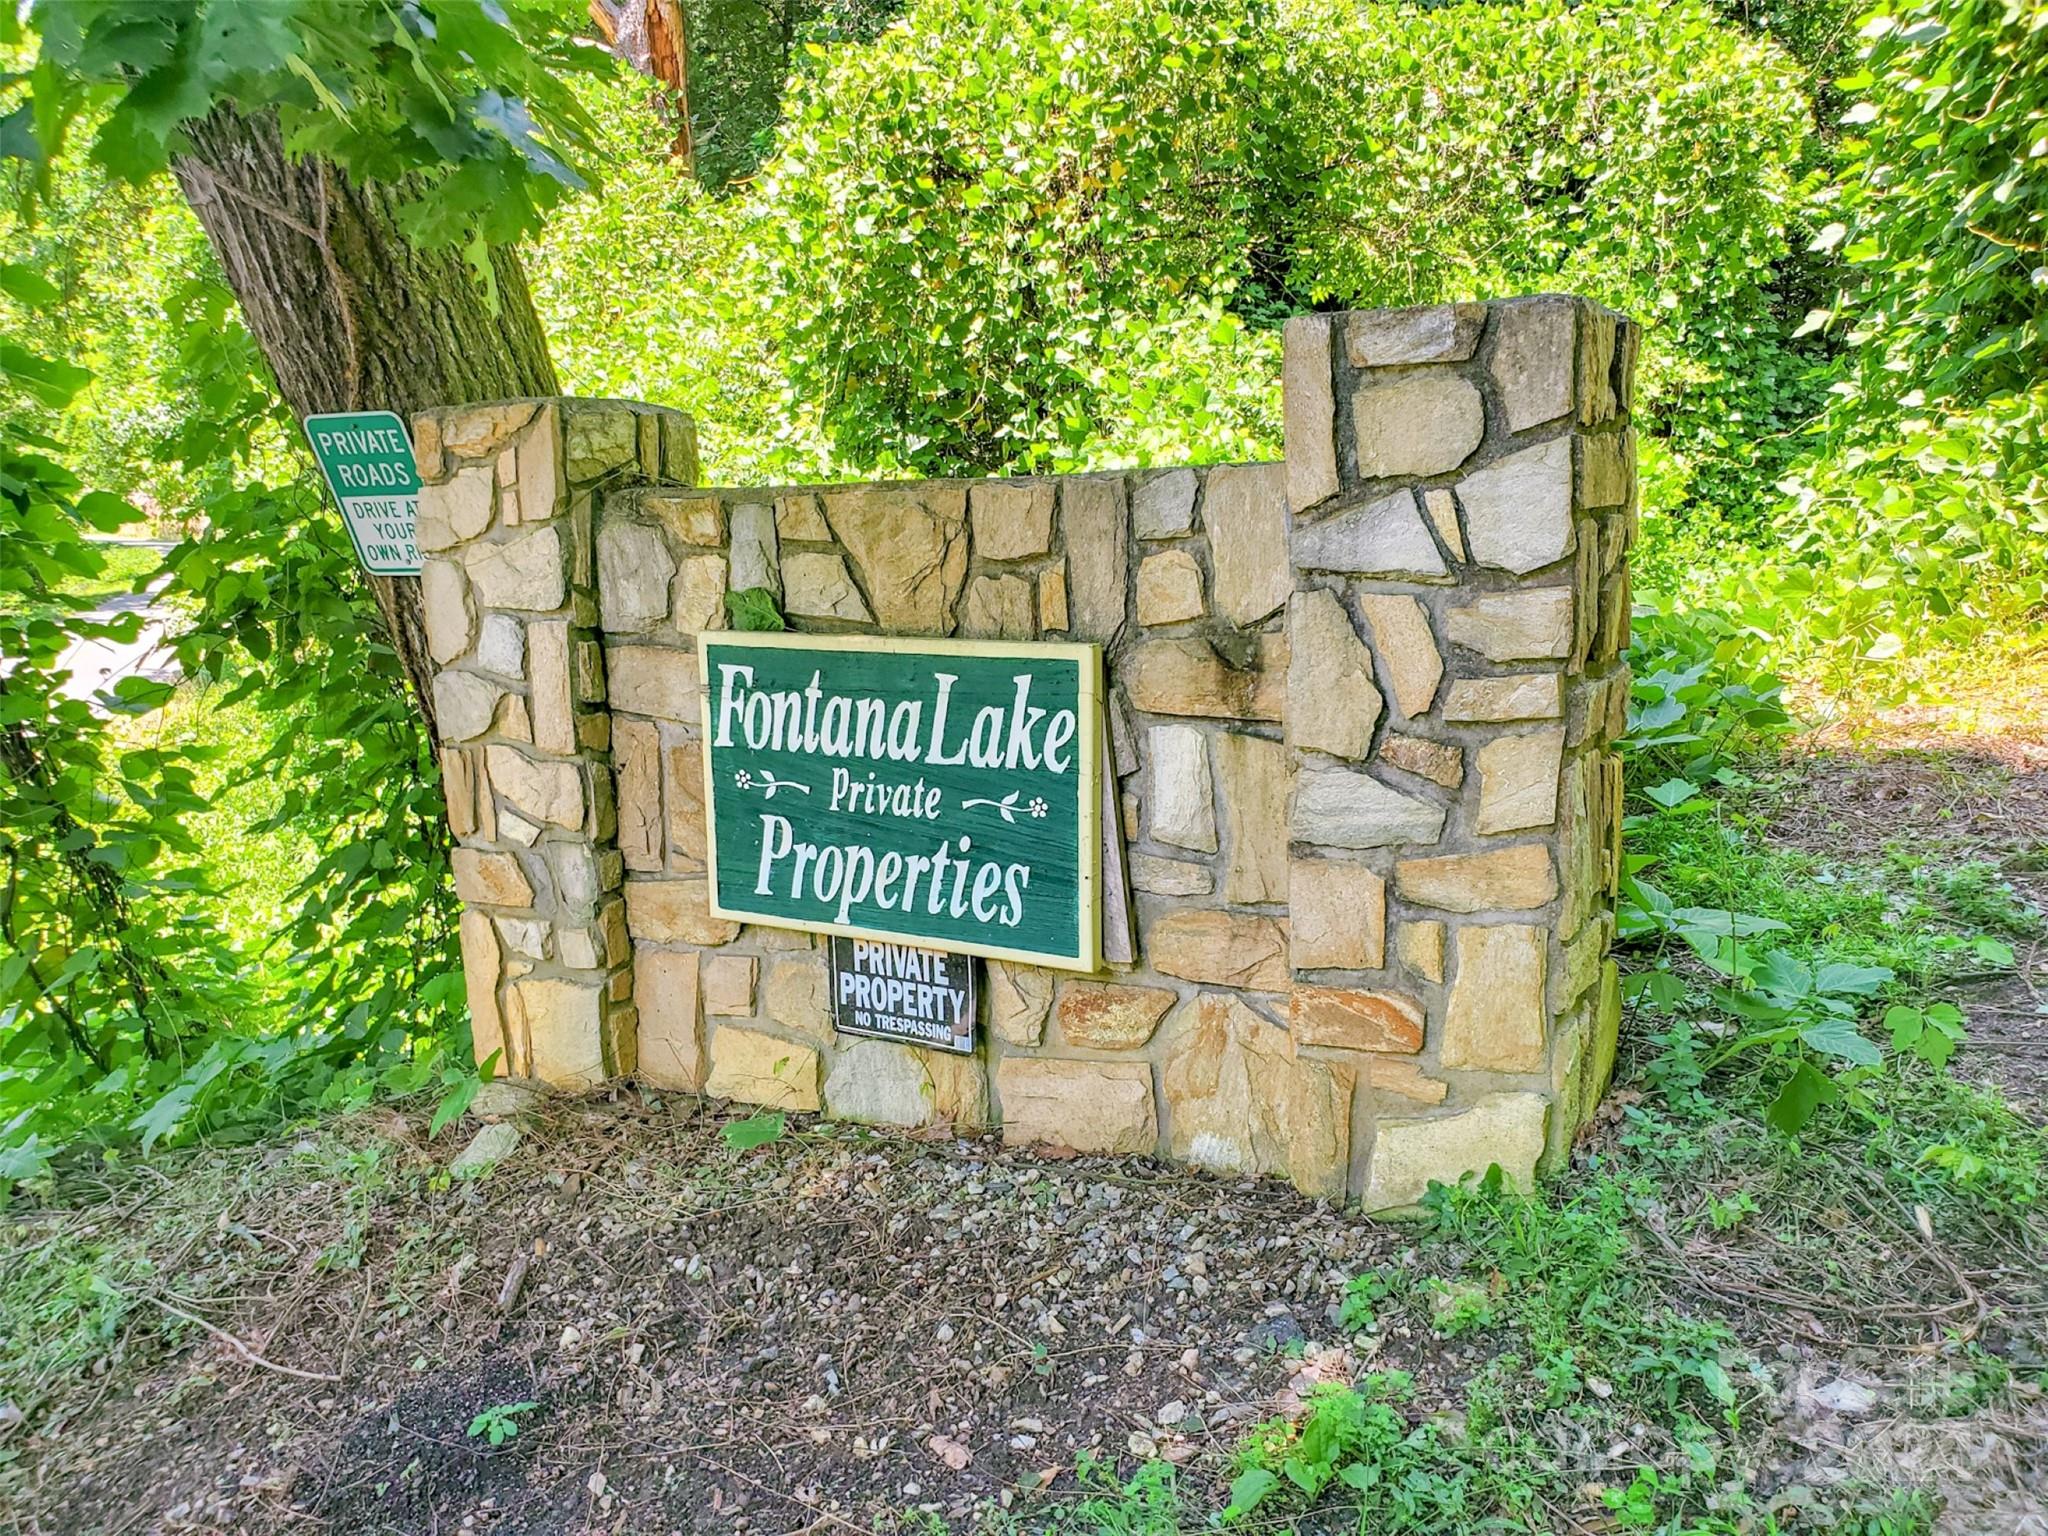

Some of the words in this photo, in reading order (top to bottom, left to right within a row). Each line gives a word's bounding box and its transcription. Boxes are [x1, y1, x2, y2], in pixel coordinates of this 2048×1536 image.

[317, 429, 406, 456] PRIVATE
[337, 462, 411, 488] ROADS
[353, 501, 401, 519] DRIVE
[373, 522, 416, 540] YOUR
[367, 545, 401, 561] OWN
[923, 672, 1076, 775] Lake
[829, 766, 942, 820] Private
[754, 813, 1031, 928] Properties
[853, 938, 950, 986] PRIVATE
[839, 971, 966, 1025] PROPERTY
[855, 1011, 872, 1026] NO
[874, 1013, 952, 1042] TRESPASSING
